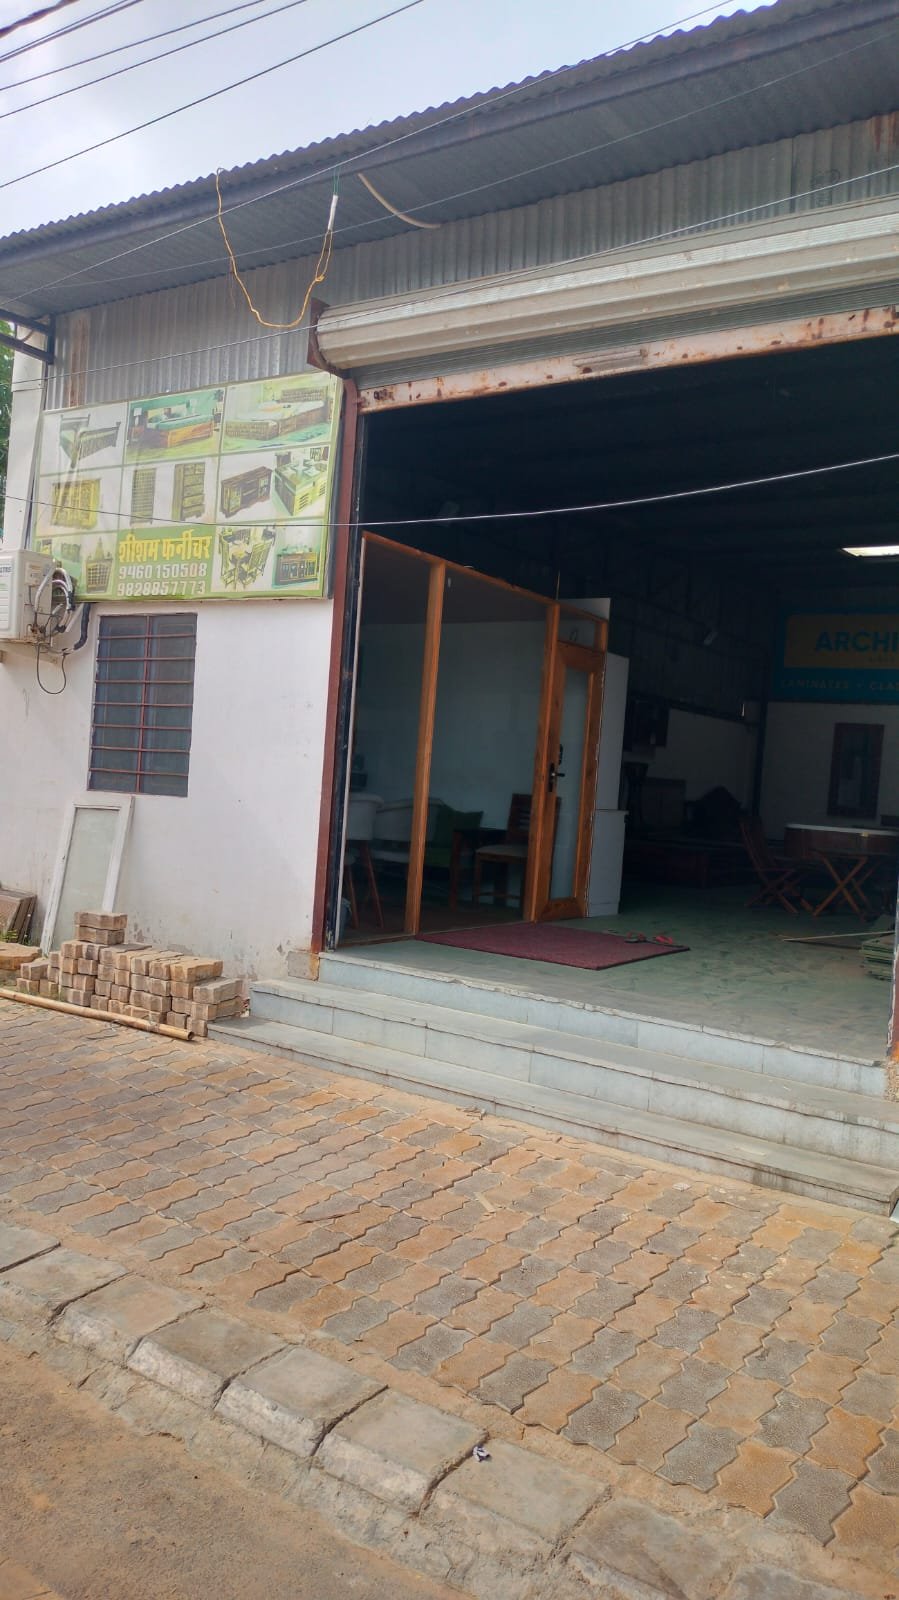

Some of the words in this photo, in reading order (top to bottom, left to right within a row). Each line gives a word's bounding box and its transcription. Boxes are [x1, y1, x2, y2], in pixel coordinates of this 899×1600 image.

[119, 533, 160, 562] शीशम
[162, 529, 212, 560] फर्नीचर
[117, 580, 206, 596] 9828857773
